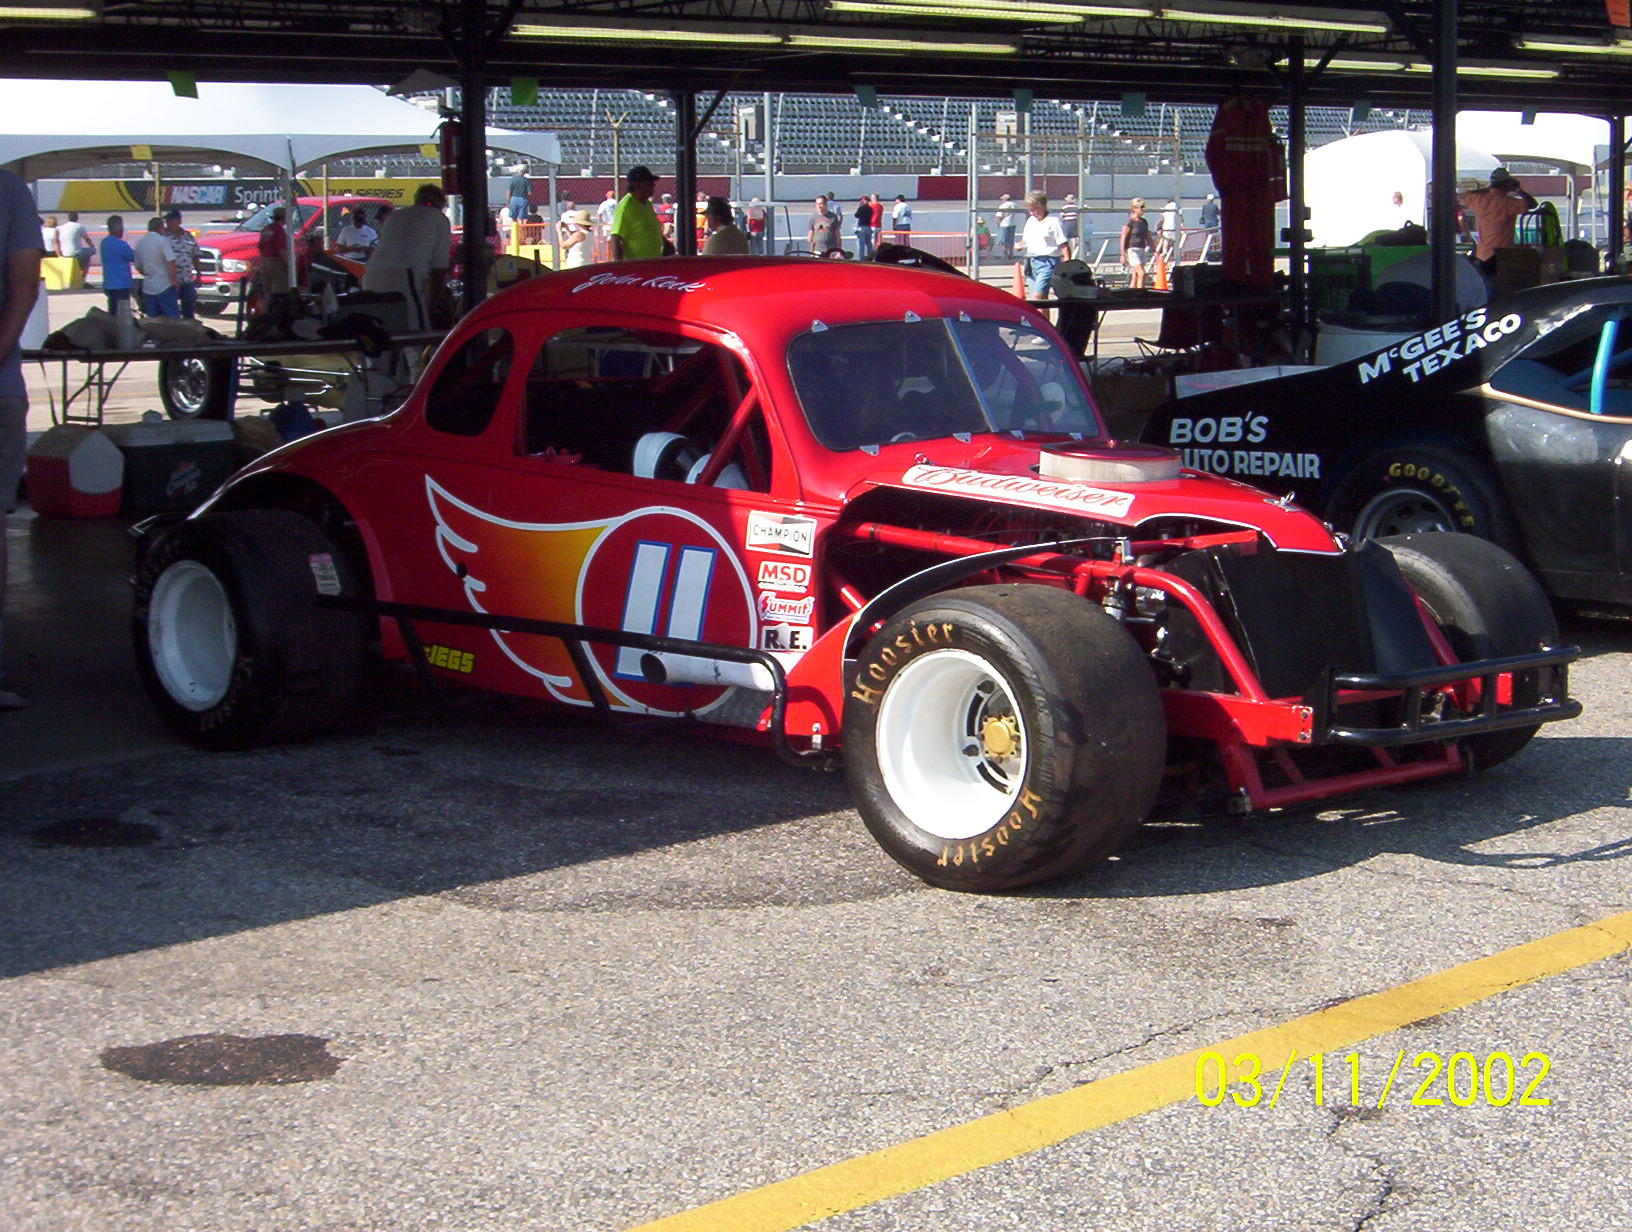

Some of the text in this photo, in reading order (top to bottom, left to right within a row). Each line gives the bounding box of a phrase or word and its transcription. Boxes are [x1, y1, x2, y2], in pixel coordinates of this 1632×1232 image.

[170, 186, 226, 204] NASCAR
[1403, 313, 1522, 383] TEXACO
[1169, 411, 1269, 443] BOB'S
[1181, 448, 1321, 479] UTO REPAIR
[913, 465, 1129, 506] Budweiser
[753, 524, 808, 542] CHAMPION
[761, 563, 807, 584] MSD
[851, 620, 954, 705] Hoosier
[936, 784, 1043, 867] Hoosier
